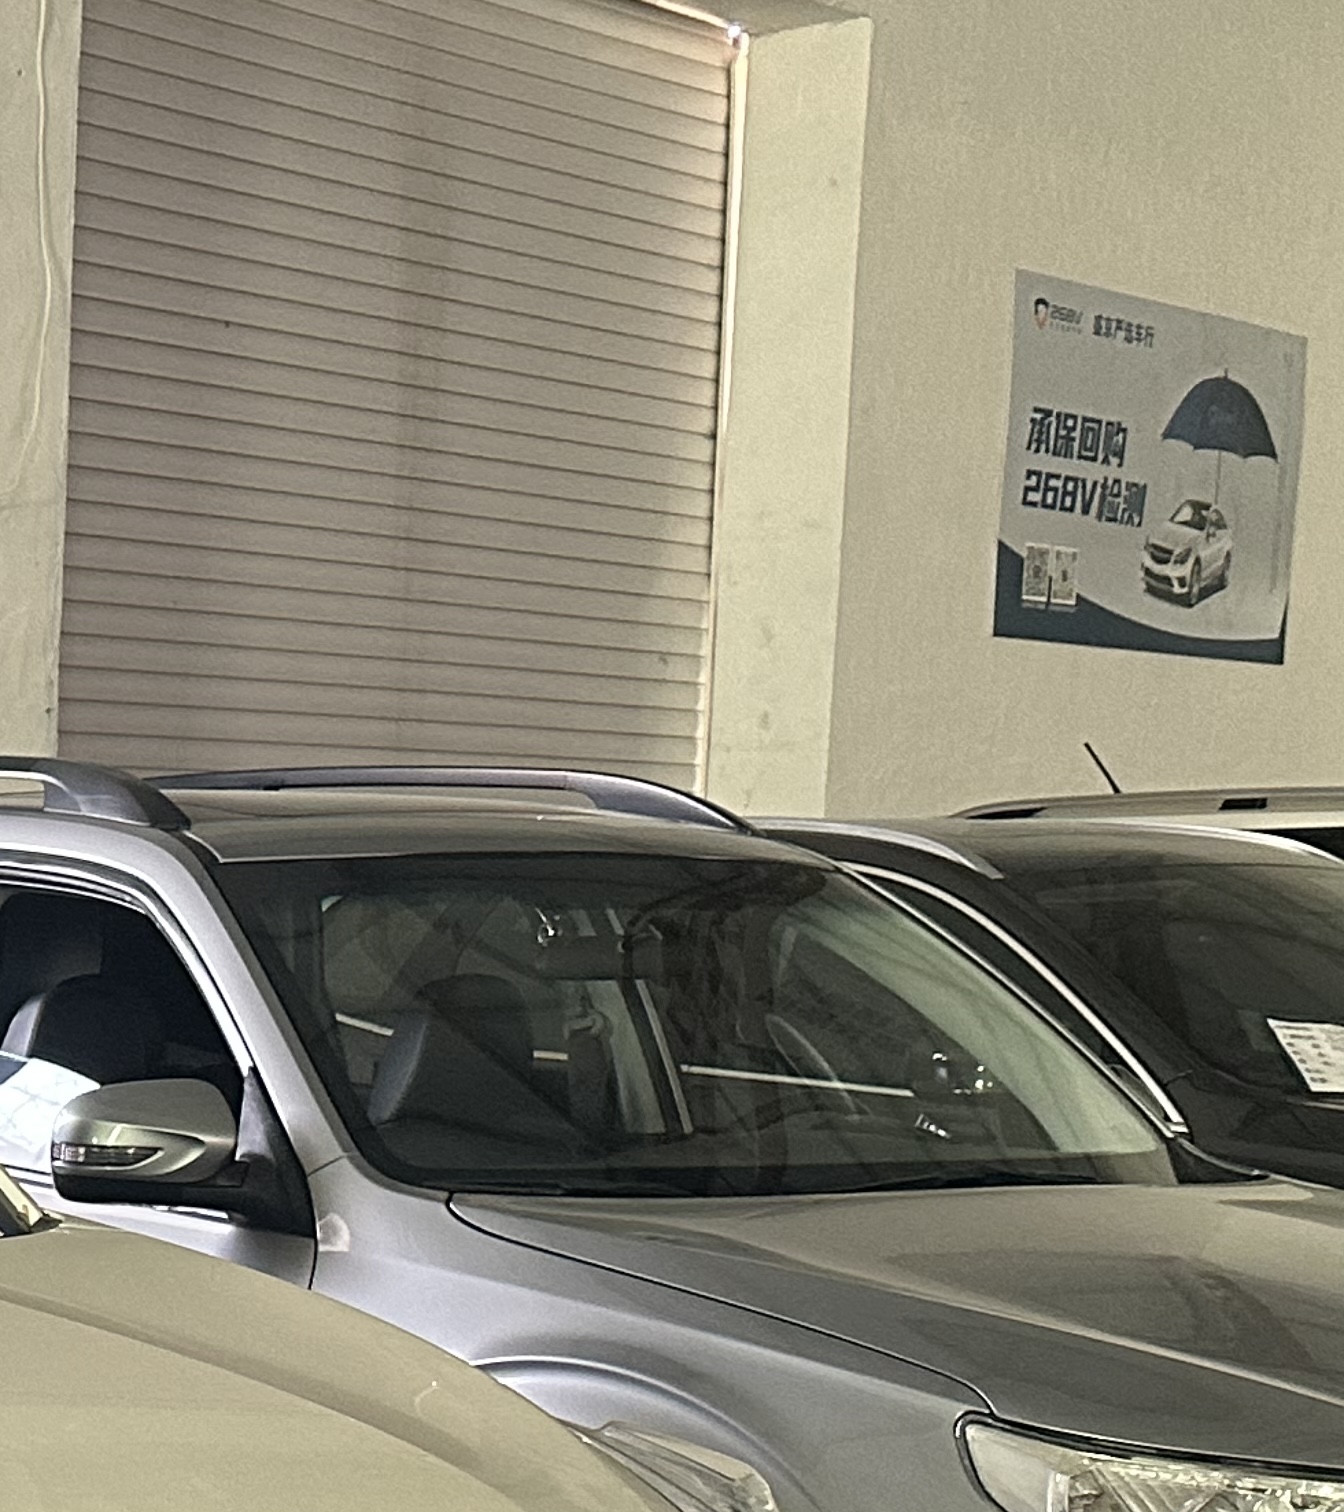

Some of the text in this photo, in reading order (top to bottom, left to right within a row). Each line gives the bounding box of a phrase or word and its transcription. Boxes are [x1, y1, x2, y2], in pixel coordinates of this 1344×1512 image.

[1026, 406, 1128, 468] 承保回购
[1021, 468, 1148, 527] 268V检测
